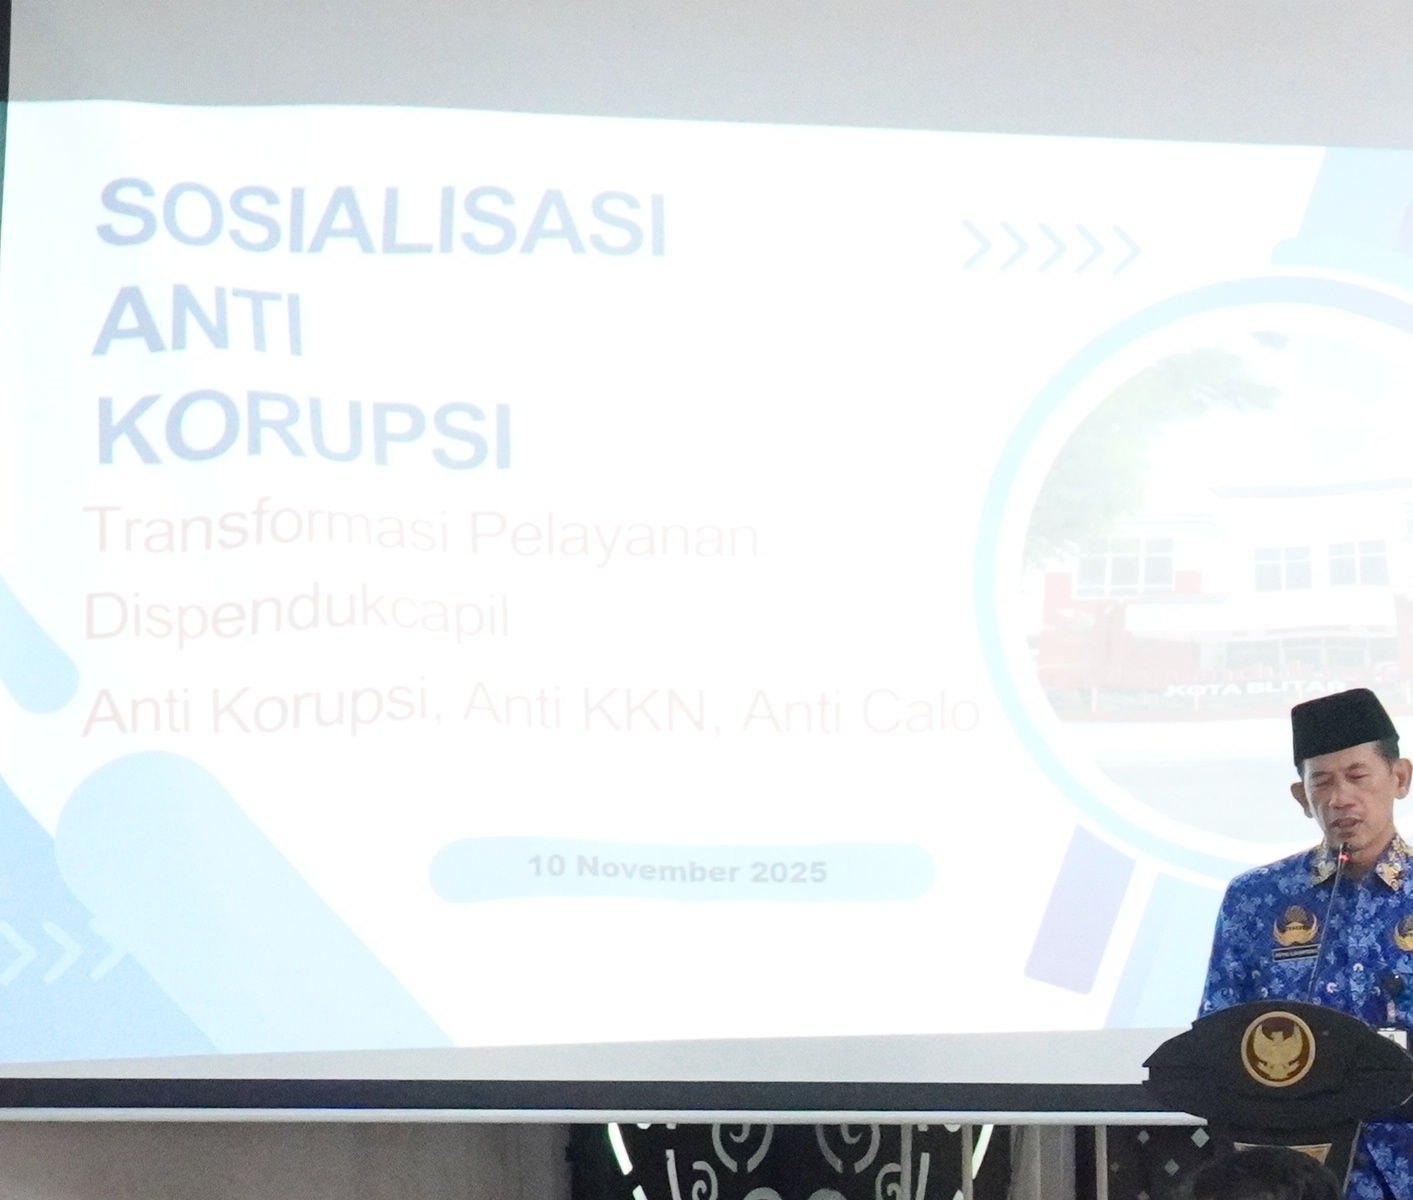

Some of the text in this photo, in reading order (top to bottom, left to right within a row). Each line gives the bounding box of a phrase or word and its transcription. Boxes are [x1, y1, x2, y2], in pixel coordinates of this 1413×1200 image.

[96, 177, 666, 256] SOSIALISASI
[91, 283, 303, 356] ANTI
[98, 389, 511, 471] KORUPSI
[82, 496, 760, 568] Transformasi Pelayanan
[84, 582, 509, 650] Dispendukcapil
[81, 675, 981, 738] Anti Korupsi, Anti KKN, Anti Calo
[1165, 683, 1242, 697] KOTA
[527, 854, 828, 884] 10 November 2025
